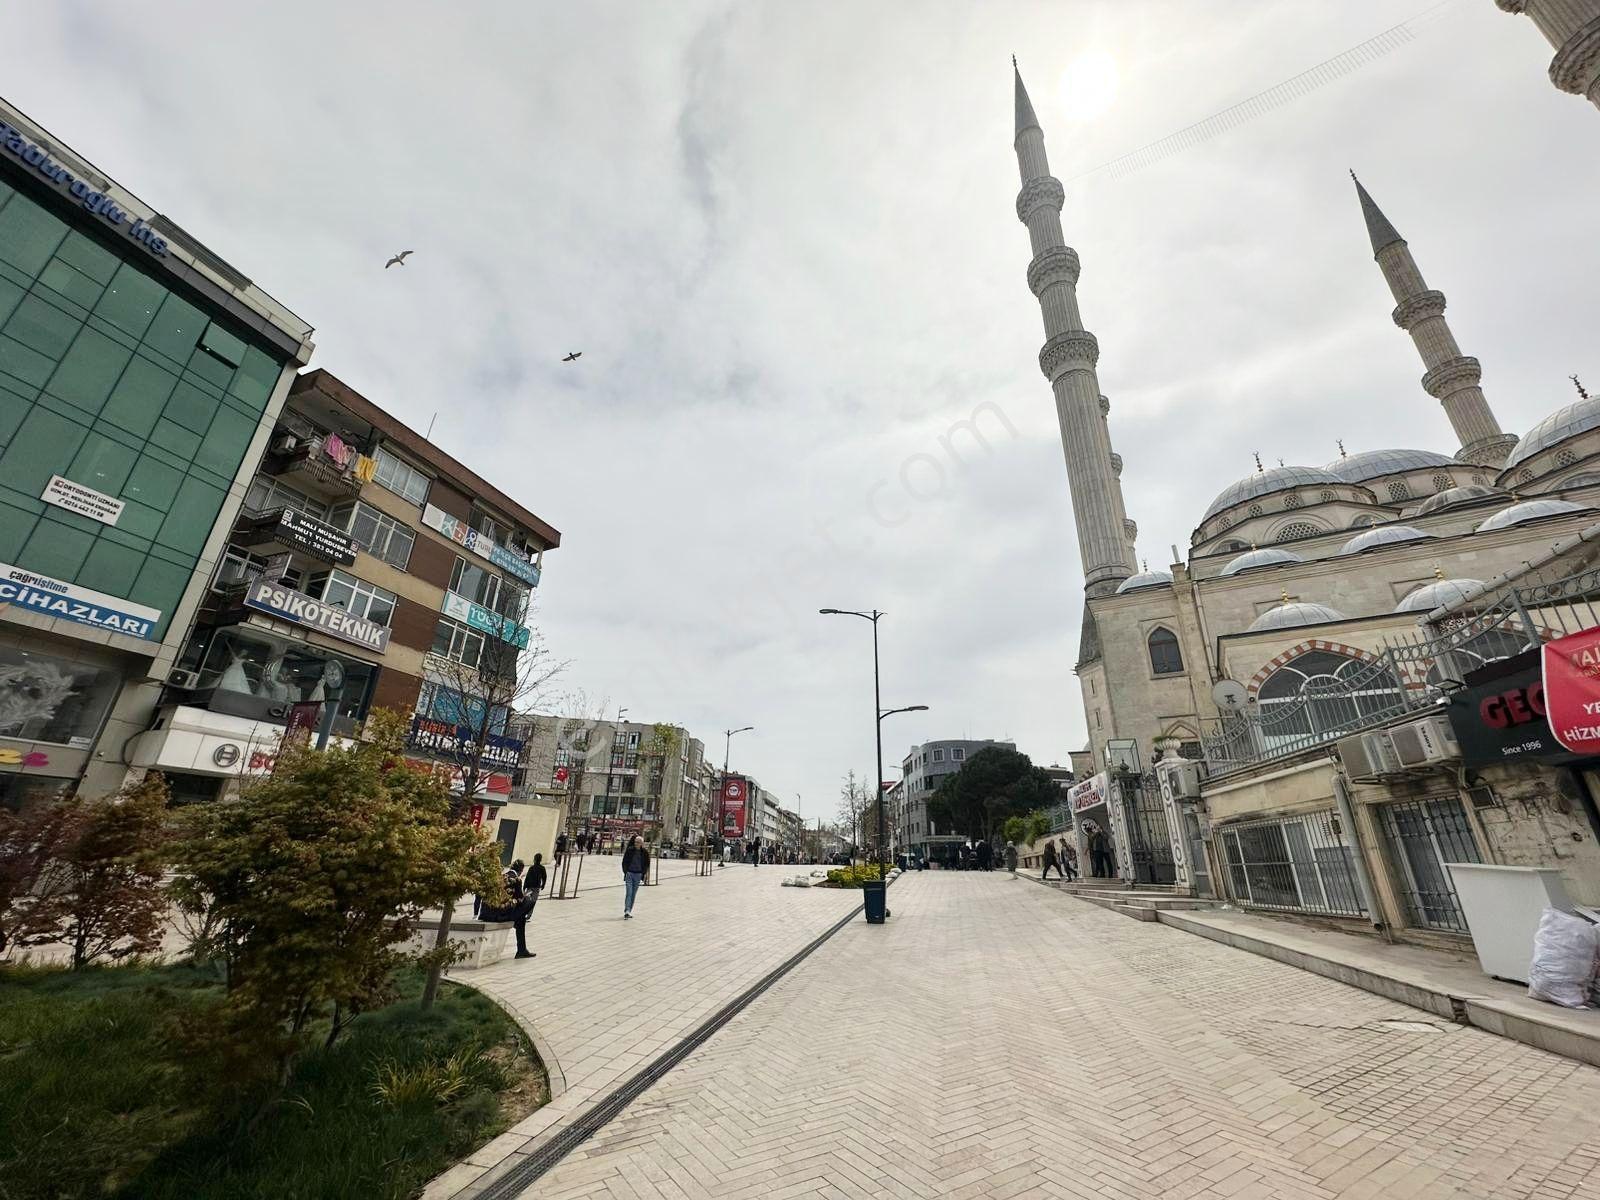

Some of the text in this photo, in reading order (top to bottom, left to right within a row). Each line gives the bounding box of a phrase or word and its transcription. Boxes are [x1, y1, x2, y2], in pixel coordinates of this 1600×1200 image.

[280, 519, 313, 537] MAHMUT
[294, 533, 307, 544] TEL
[0, 584, 149, 635] CİHAZLARI
[256, 585, 384, 645] PSİKOTEKNİK
[1502, 740, 1541, 755] Since 1996
